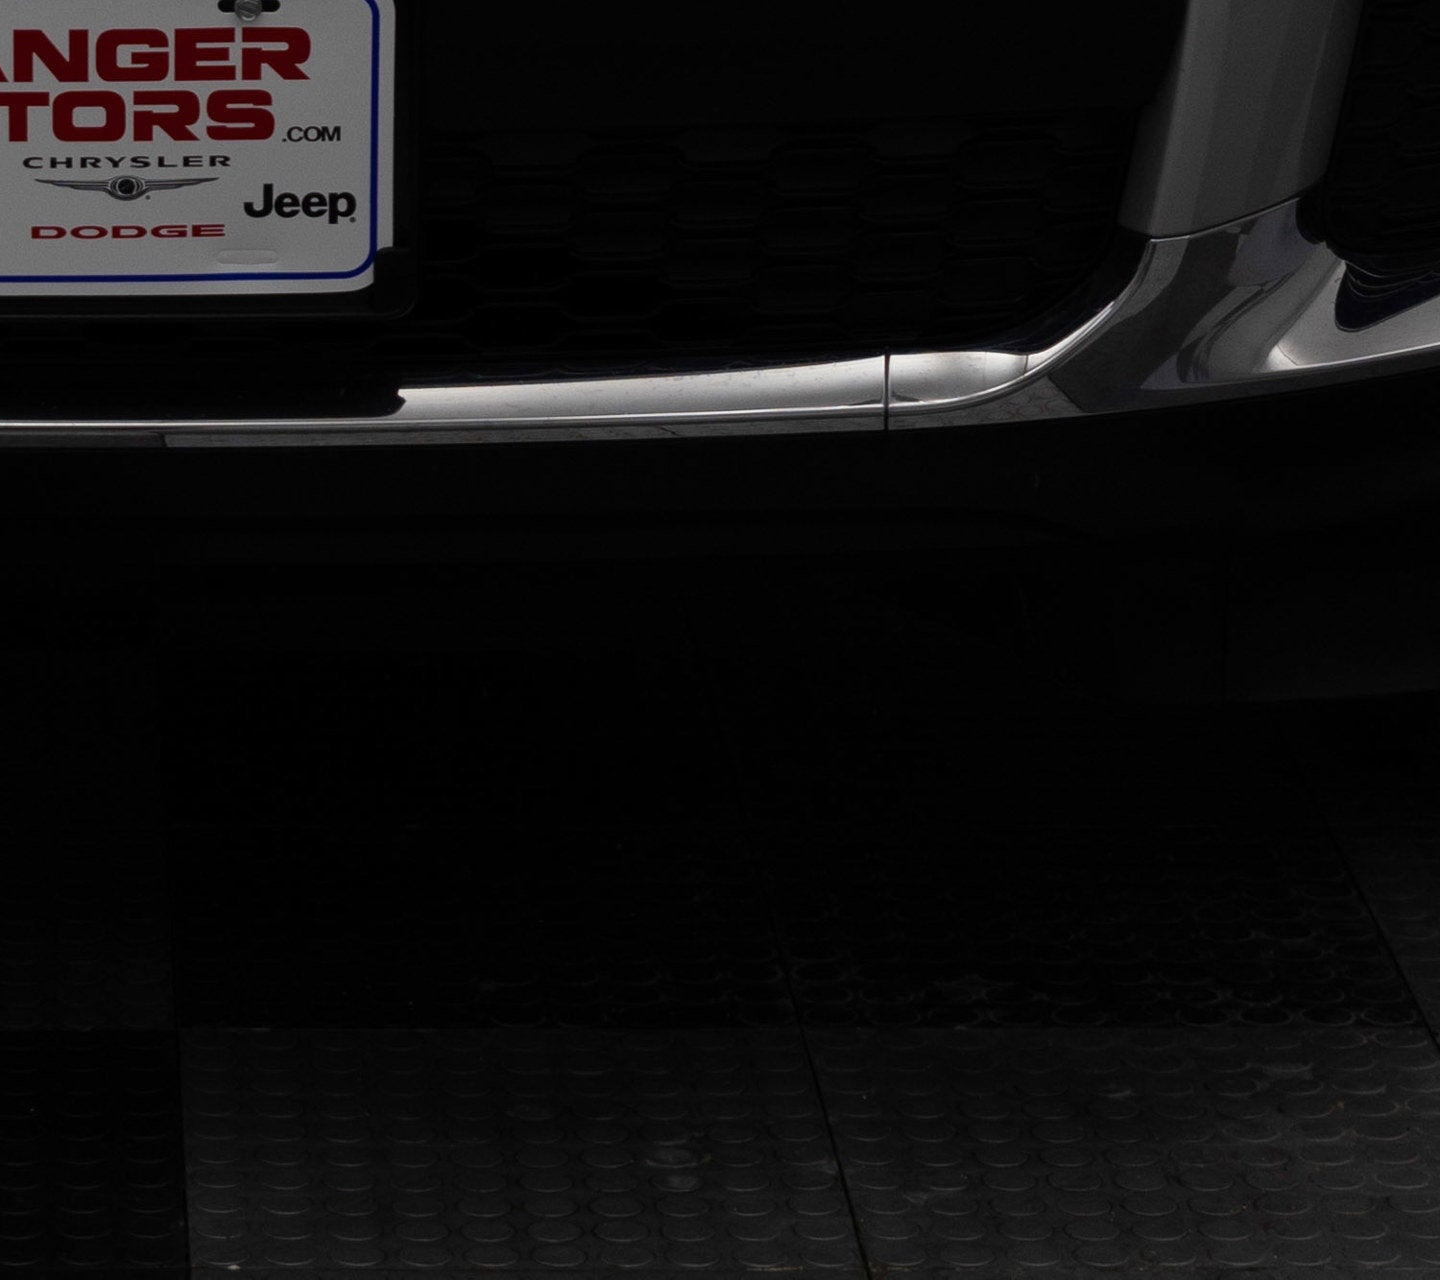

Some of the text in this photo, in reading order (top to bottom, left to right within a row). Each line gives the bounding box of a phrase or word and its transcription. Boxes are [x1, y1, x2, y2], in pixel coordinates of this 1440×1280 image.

[281, 125, 342, 143] .COM
[22, 154, 232, 169] CHRYSLER
[244, 183, 357, 225] Jeep
[30, 224, 226, 239] DODGE
